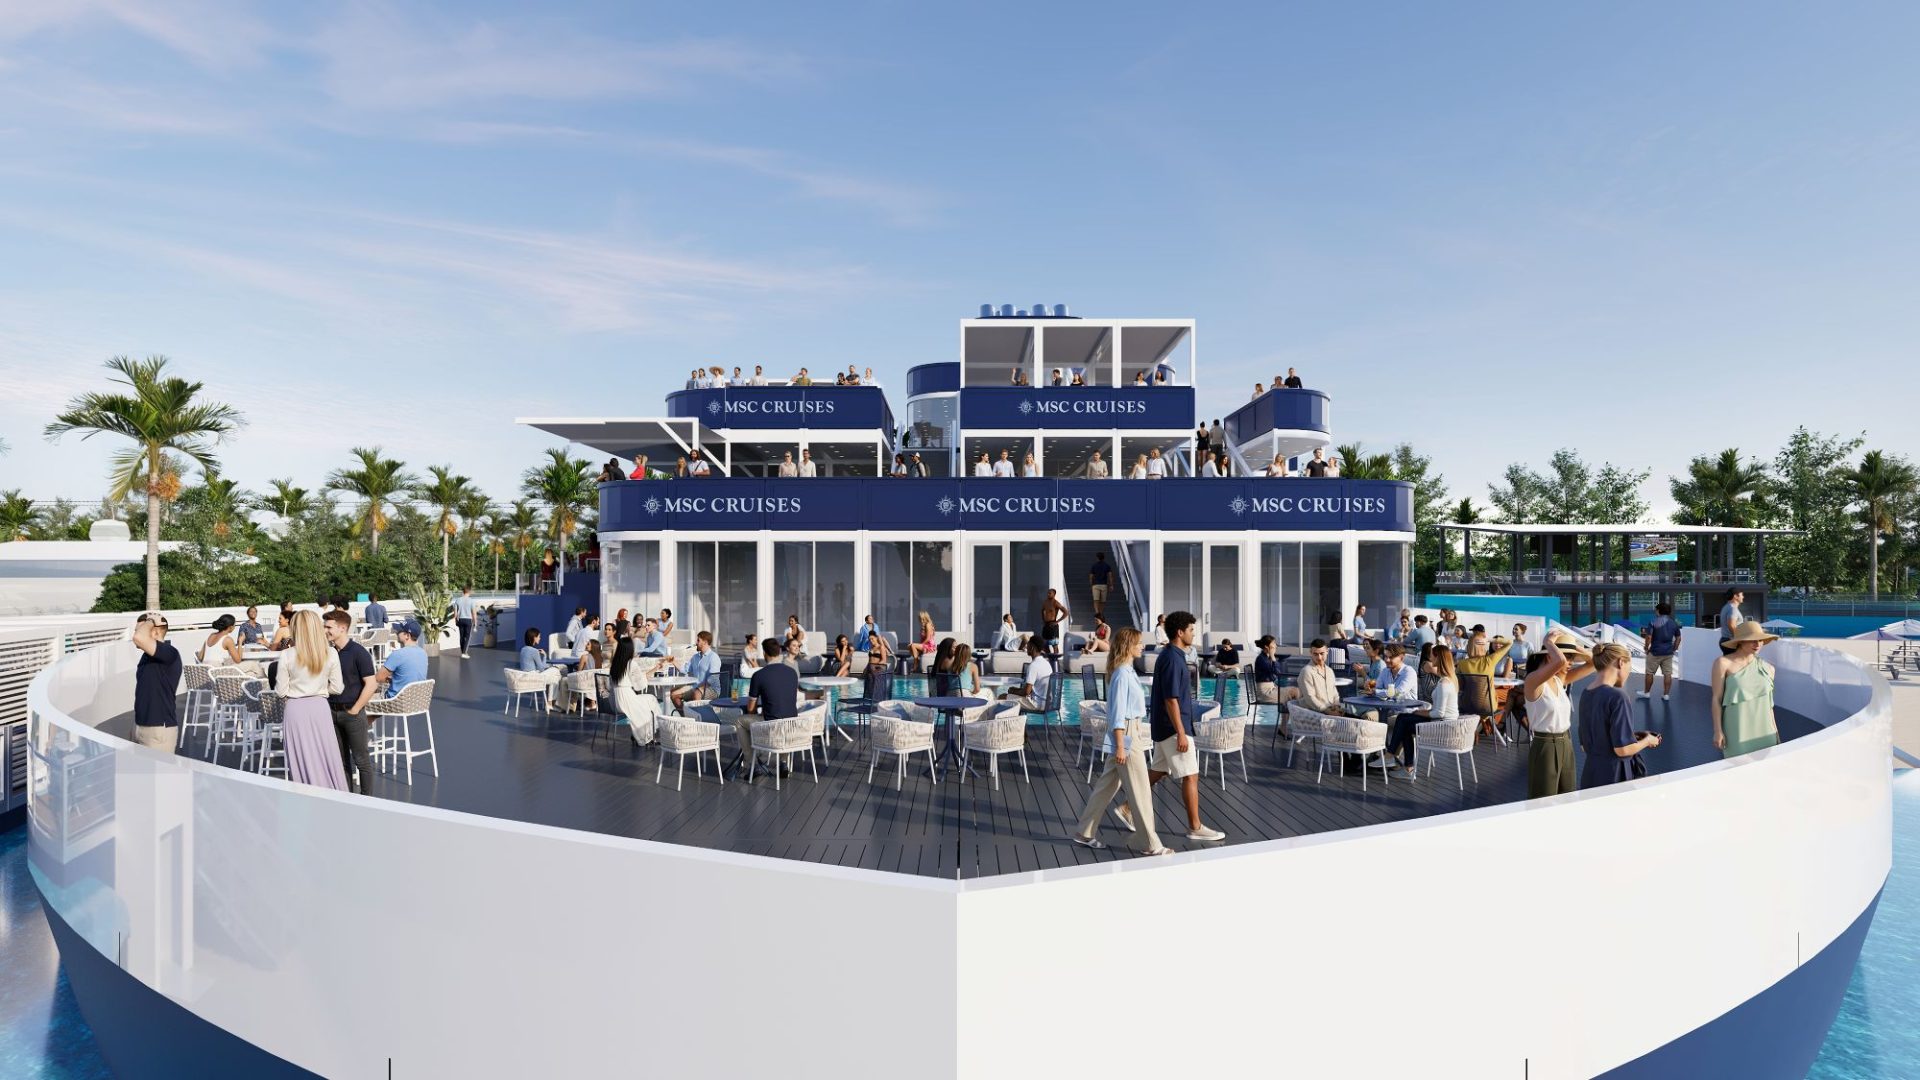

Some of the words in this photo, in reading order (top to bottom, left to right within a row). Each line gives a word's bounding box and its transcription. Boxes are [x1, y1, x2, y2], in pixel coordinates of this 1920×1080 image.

[724, 400, 757, 413] MSC
[761, 400, 834, 413] CRUISES
[1036, 400, 1069, 413] MSC
[1073, 400, 1146, 413] CRUISES
[664, 497, 706, 513] MSC
[710, 497, 801, 513] CRUISES
[958, 497, 999, 513] MSC
[1004, 497, 1095, 513] CRUISES
[1252, 497, 1293, 513] MSC
[1297, 497, 1386, 513] CRUISES
